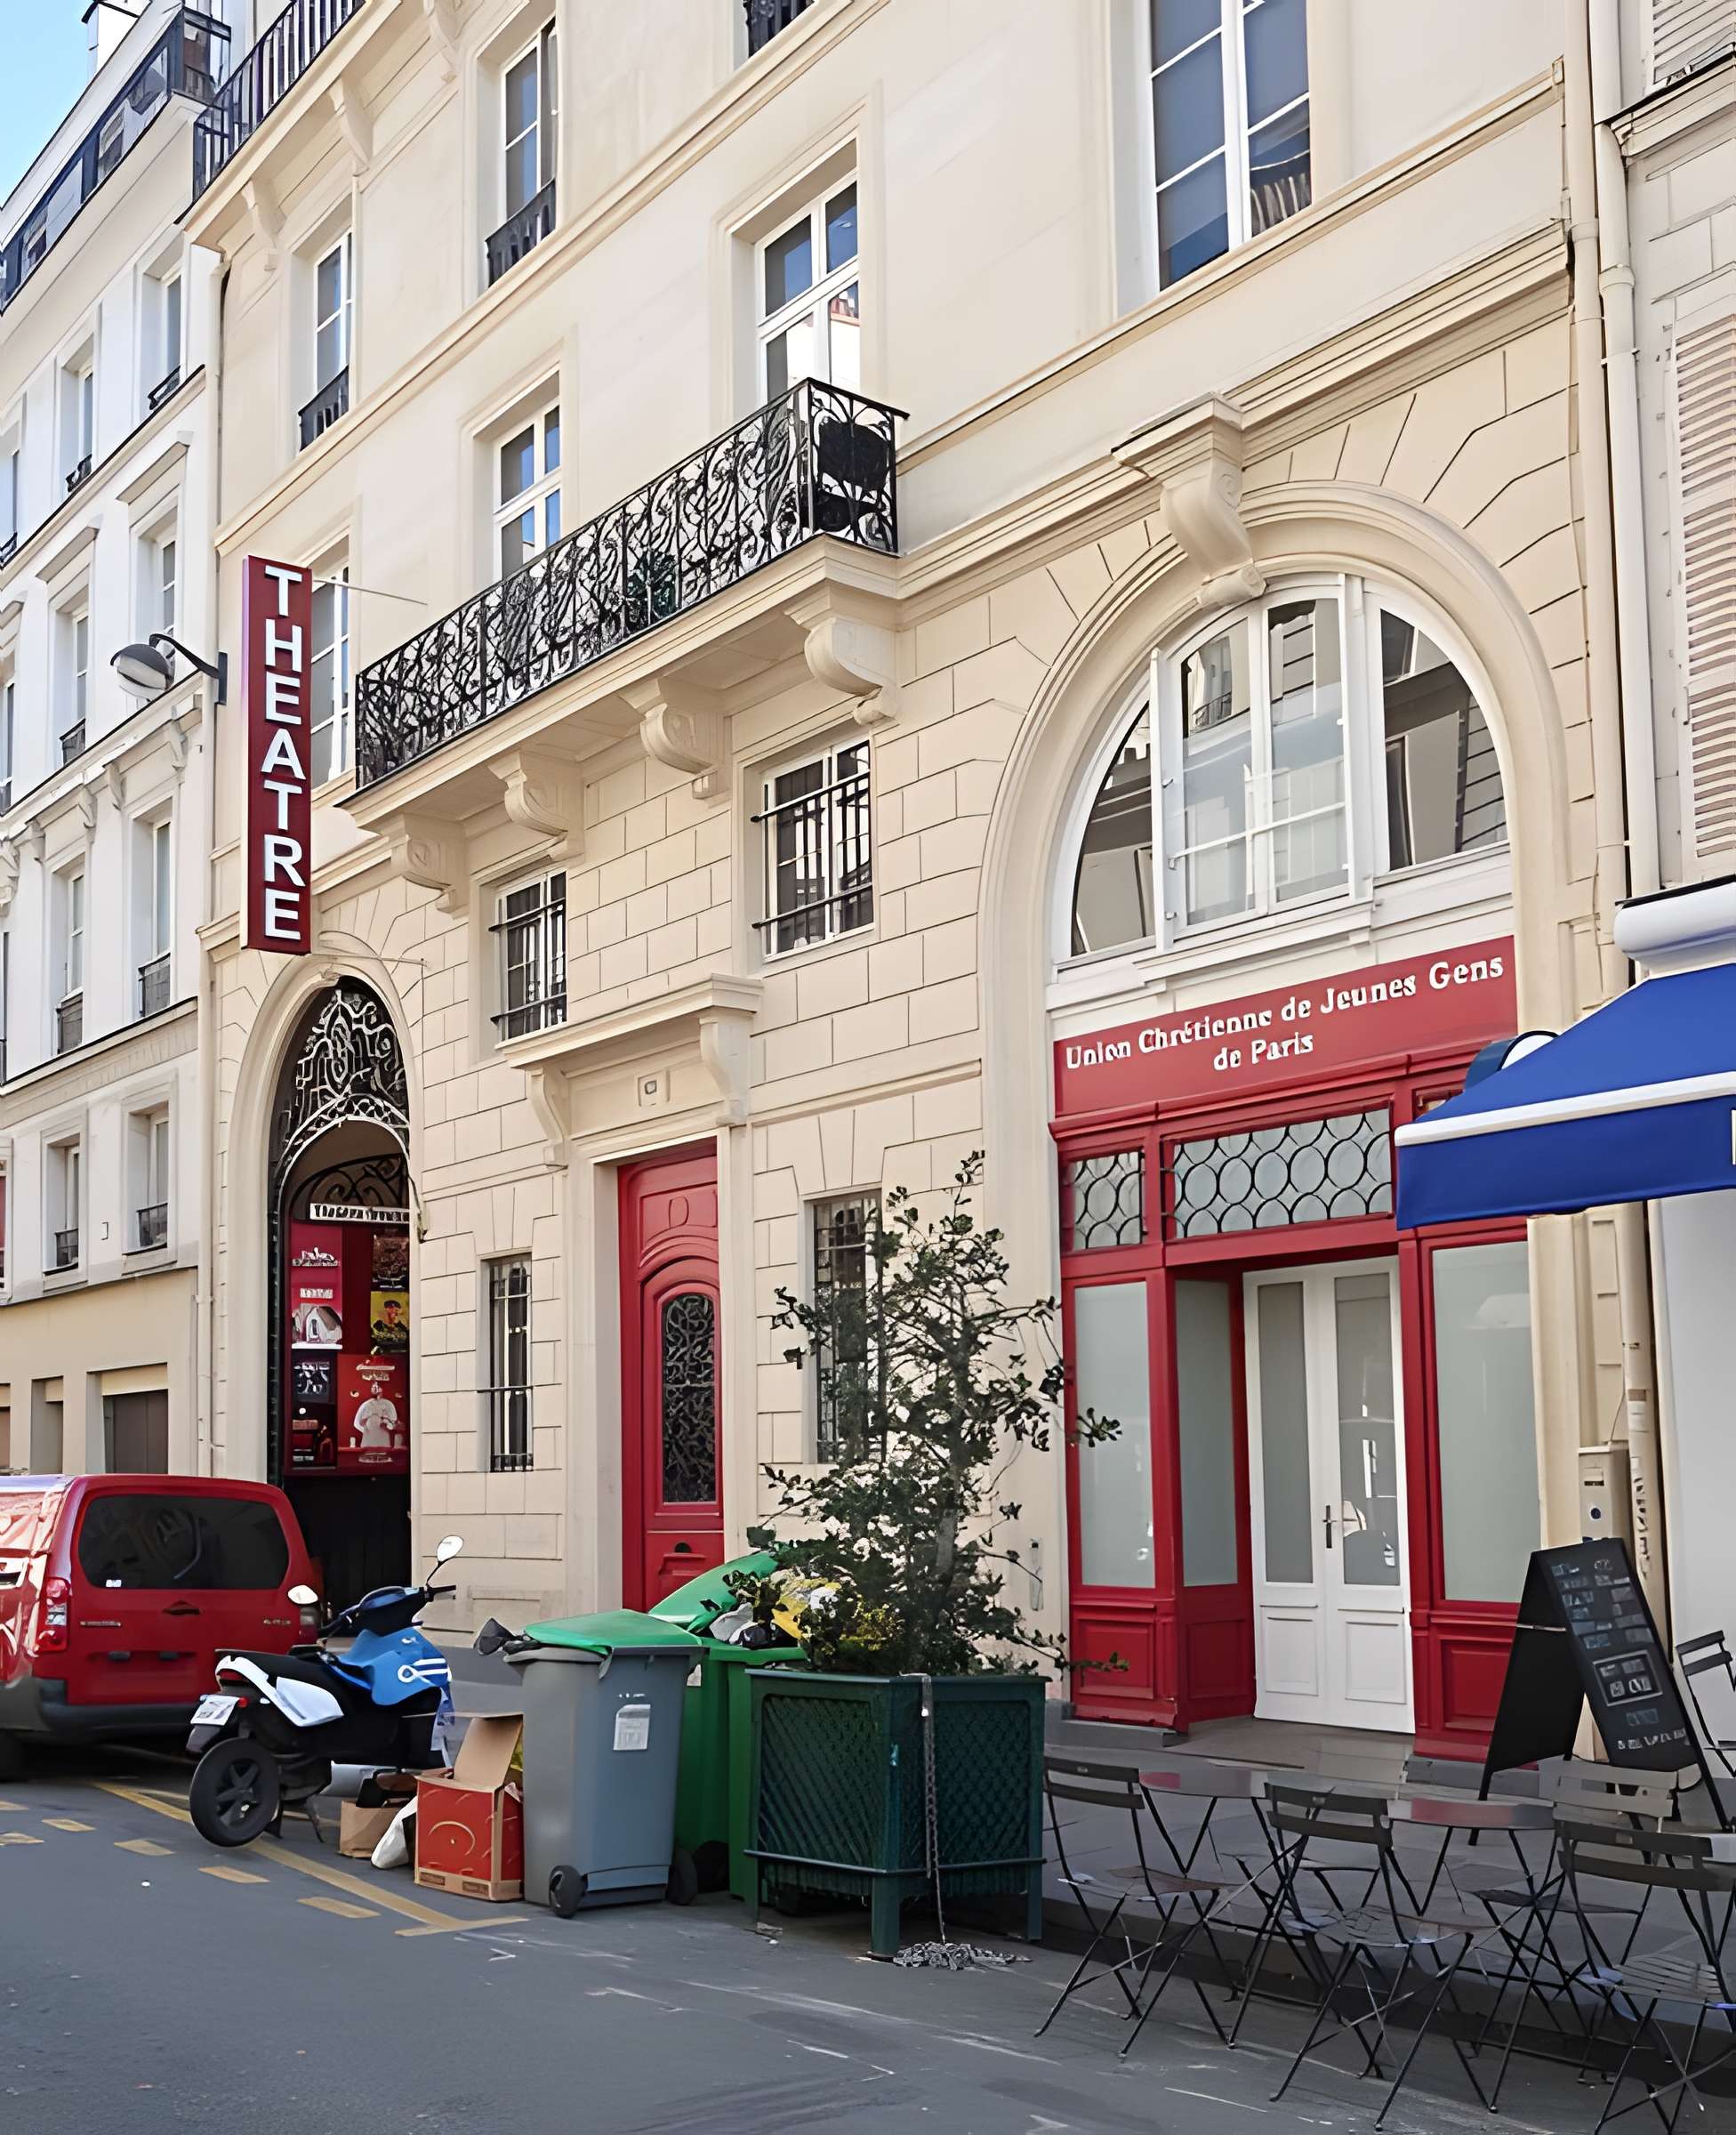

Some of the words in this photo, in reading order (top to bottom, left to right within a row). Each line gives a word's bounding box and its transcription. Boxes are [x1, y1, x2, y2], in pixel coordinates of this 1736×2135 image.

[261, 564, 307, 941] THEATRE
[1066, 1039, 1131, 1069] Union
[1281, 996, 1312, 1021] de
[1320, 973, 1417, 1015] Jeunes
[1428, 956, 1504, 990] Gens
[1213, 1047, 1242, 1071] de
[1251, 1030, 1314, 1065] Paris
